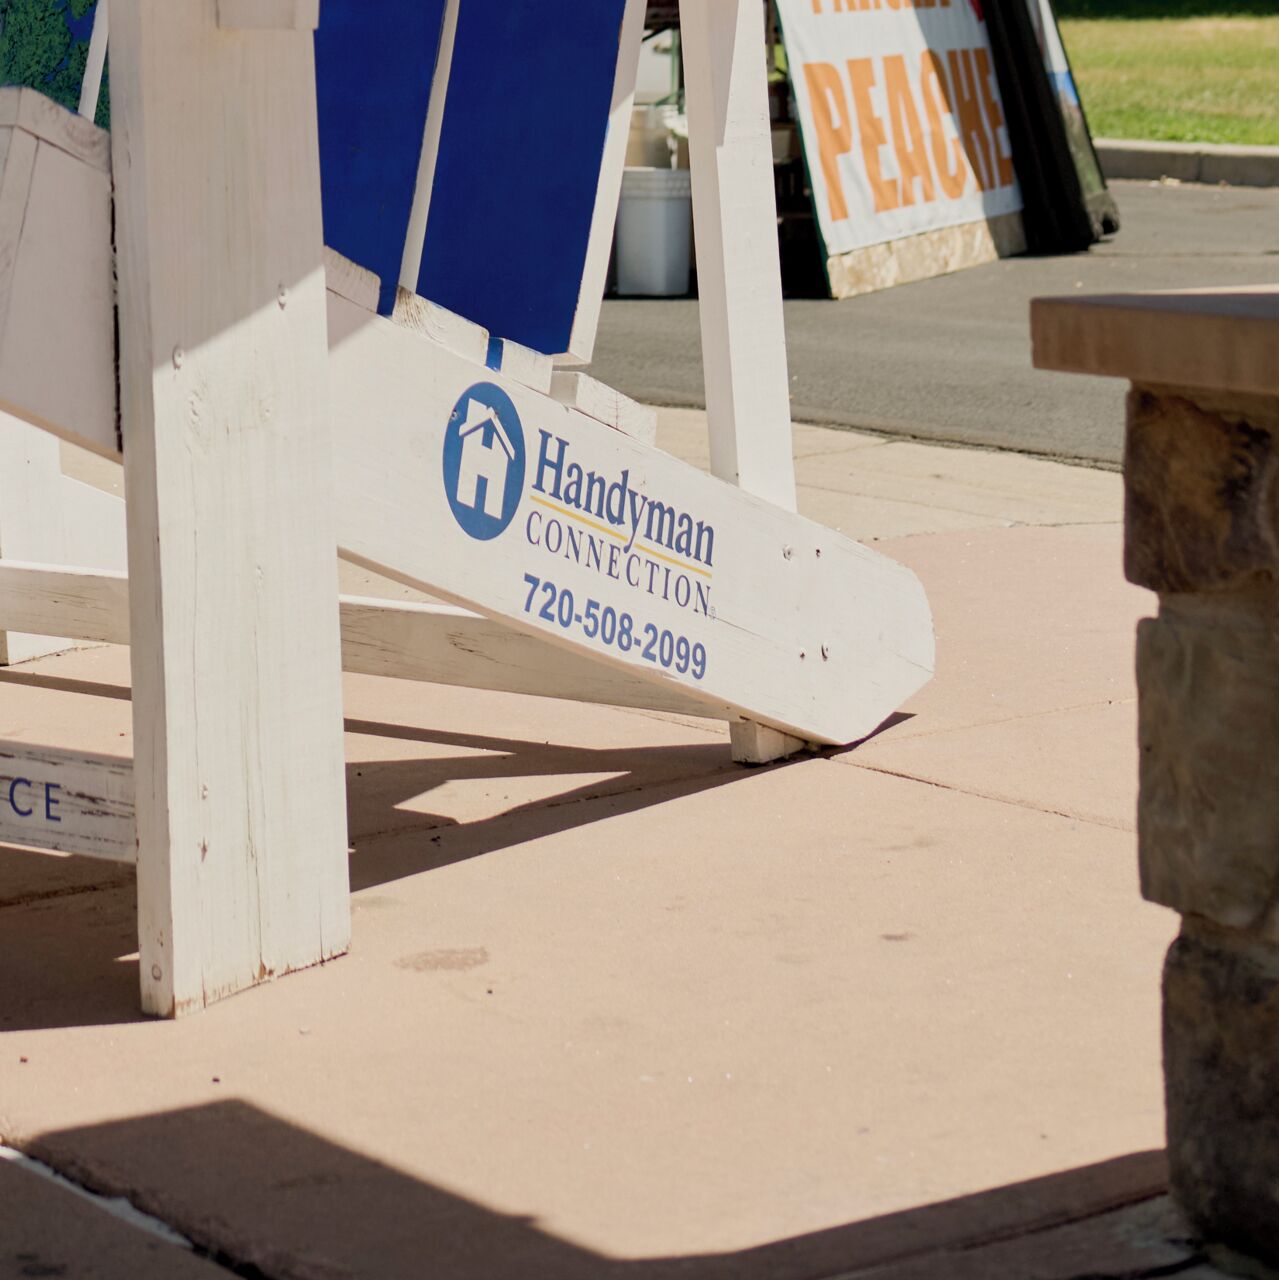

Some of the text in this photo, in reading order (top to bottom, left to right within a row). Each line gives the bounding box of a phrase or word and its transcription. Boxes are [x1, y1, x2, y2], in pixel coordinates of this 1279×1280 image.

[802, 47, 1014, 223] PEACHE
[531, 428, 715, 567] Handyman
[526, 510, 711, 617] CONNECTION
[524, 572, 707, 680] 720-508-2099
